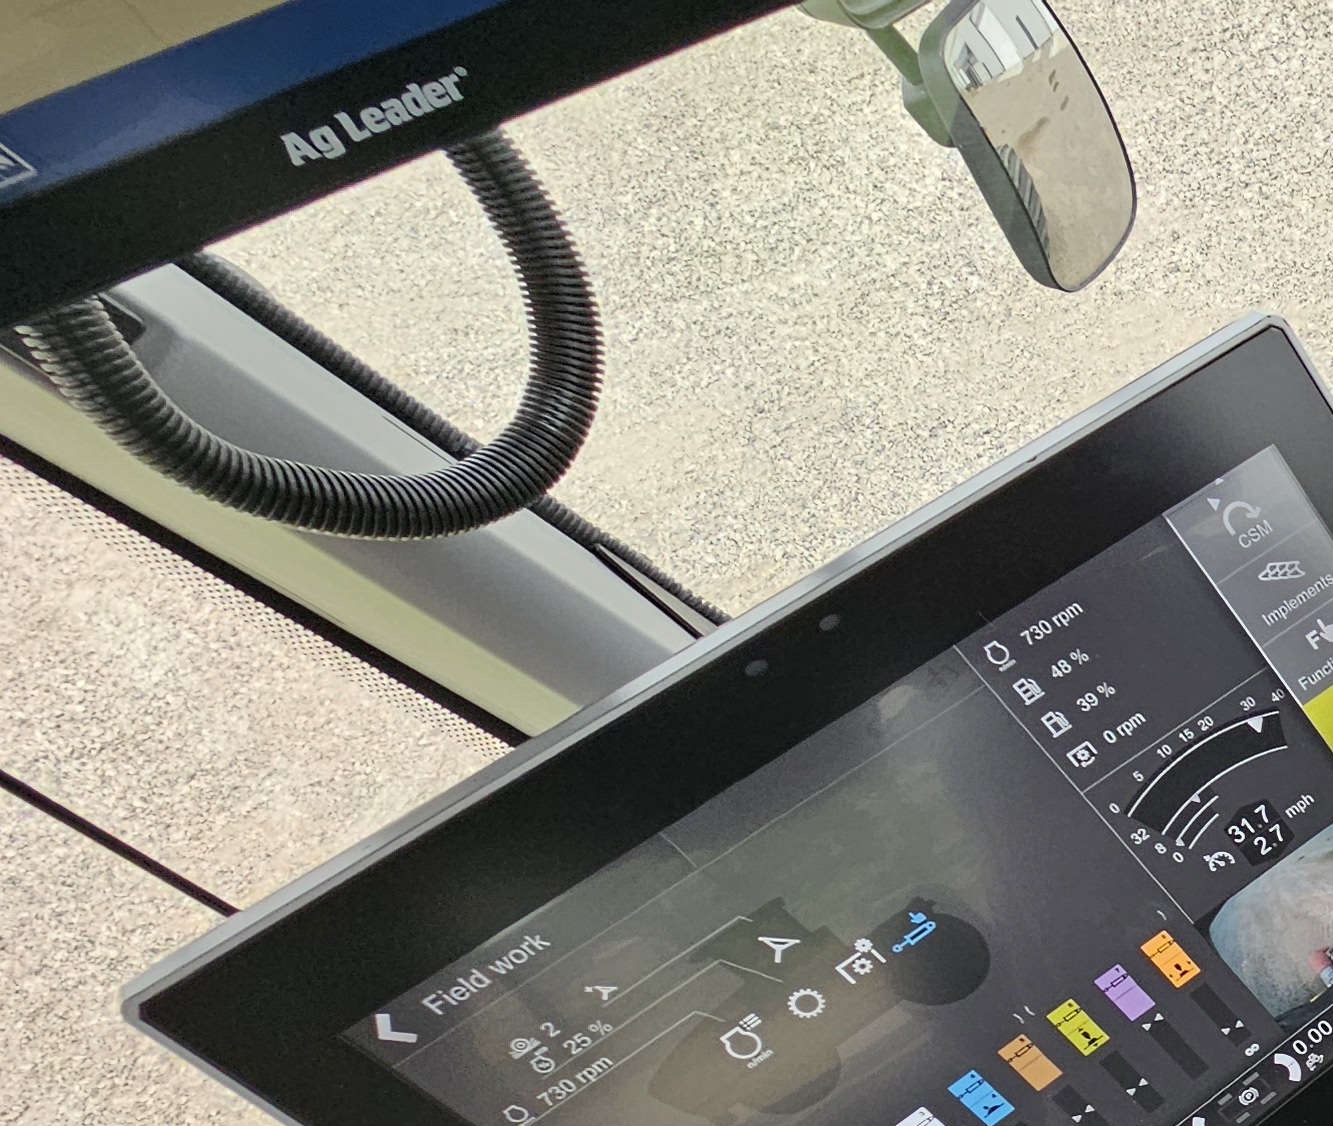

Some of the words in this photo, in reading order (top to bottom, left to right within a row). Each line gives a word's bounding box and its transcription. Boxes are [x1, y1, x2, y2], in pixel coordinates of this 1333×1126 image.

[280, 125, 347, 167] Ag
[334, 72, 465, 143] Leader
[1238, 519, 1274, 549] CSM
[1020, 620, 1054, 646] 730
[1052, 602, 1084, 627] rpm
[1051, 659, 1072, 679] 48
[1069, 648, 1090, 665] %
[1076, 692, 1099, 712] 39
[1096, 682, 1116, 698] %
[1240, 696, 1256, 711] 30
[1271, 688, 1286, 703] 40
[1102, 730, 1117, 744] 0
[1116, 712, 1147, 736] rpm
[1197, 716, 1214, 731] 20
[1178, 728, 1194, 743] 15
[1157, 744, 1173, 758] 10
[1133, 771, 1144, 782] 5
[1109, 803, 1120, 814] 0
[1285, 793, 1315, 818] mph
[1130, 828, 1150, 845] 32
[1154, 842, 1167, 855] 8
[1172, 852, 1184, 863] 0
[421, 968, 493, 1016] Field
[488, 933, 552, 976] work
[540, 1021, 561, 1038] 2
[563, 1032, 593, 1056] 25
[587, 1020, 614, 1036] %
[1292, 1020, 1333, 1056] 0.00
[536, 1079, 577, 1107] 730
[575, 1055, 614, 1083] rpm
